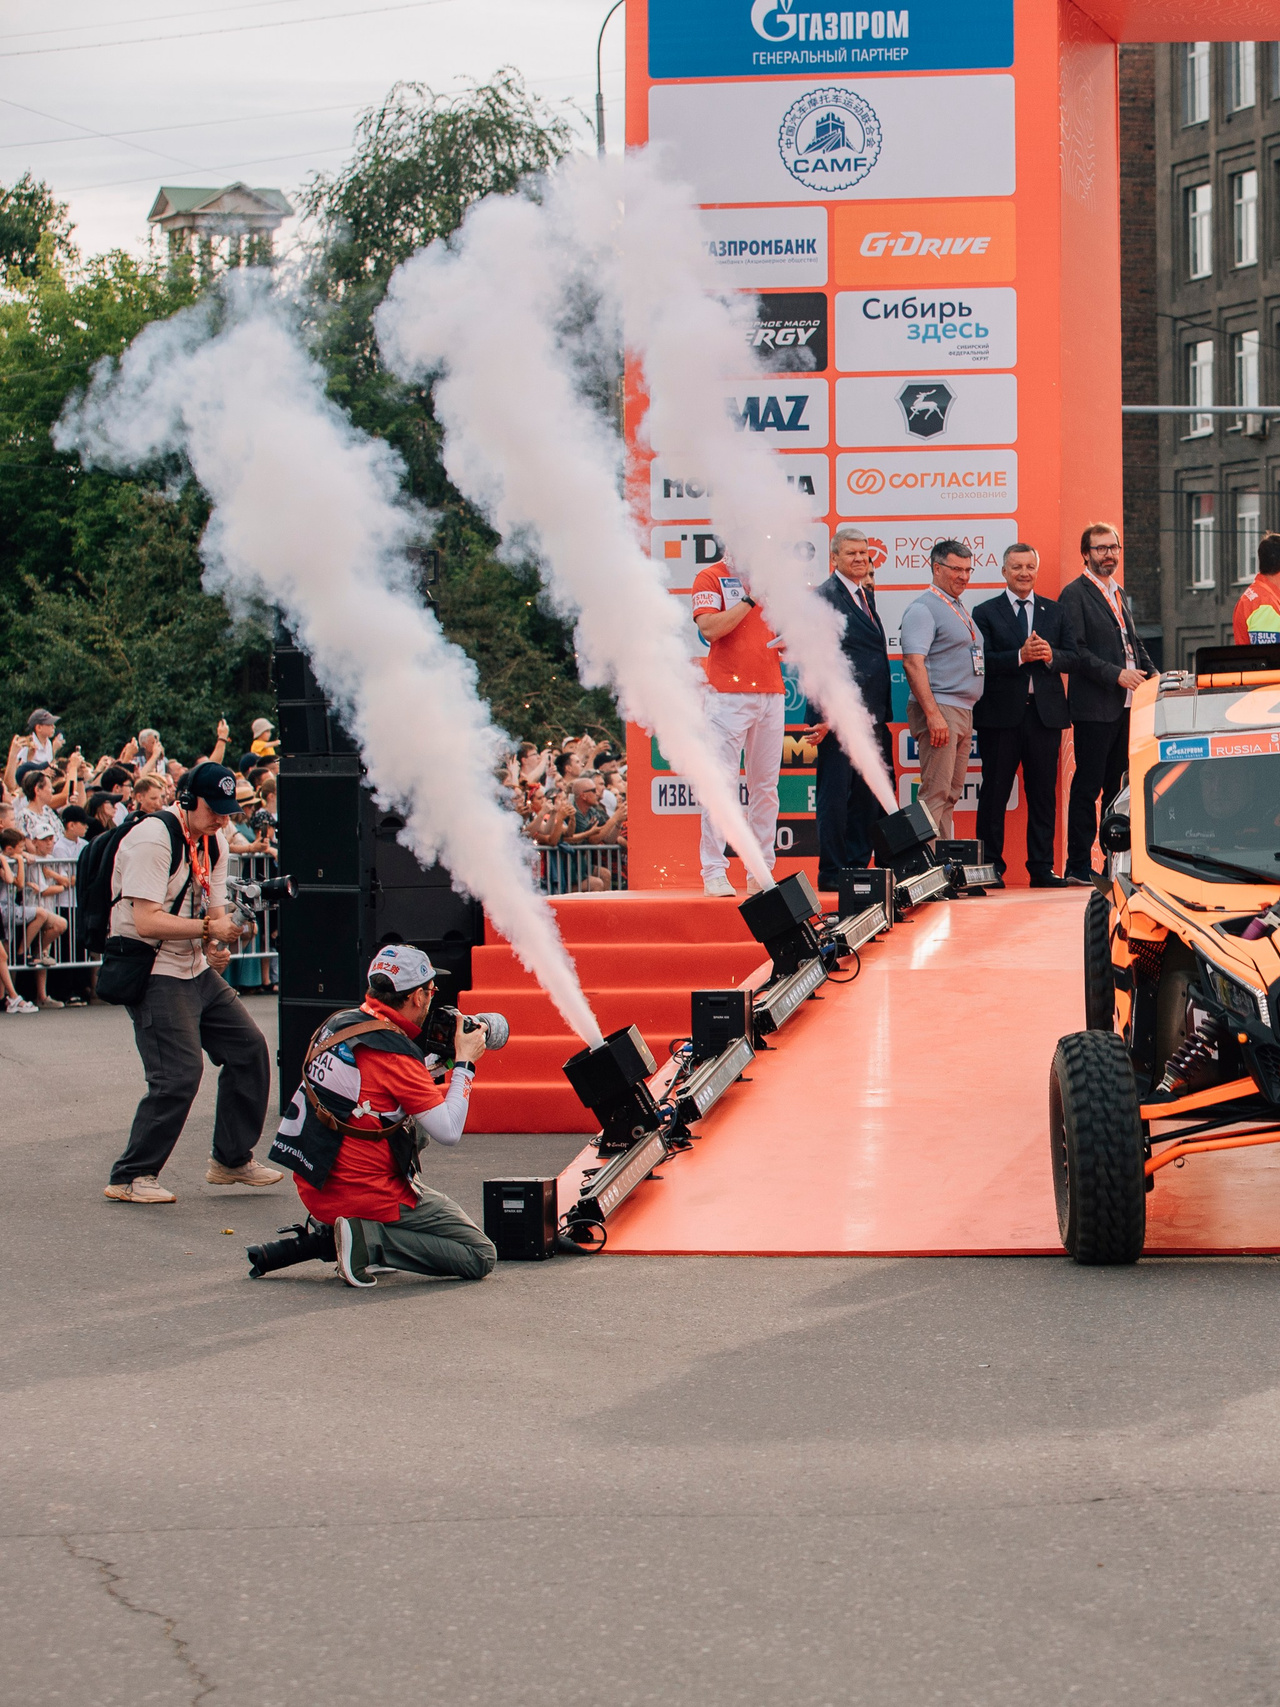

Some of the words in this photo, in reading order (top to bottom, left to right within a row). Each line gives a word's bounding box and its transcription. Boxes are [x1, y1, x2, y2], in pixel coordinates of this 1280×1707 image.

[797, 10, 909, 41] ГАЗПРОМ
[752, 48, 848, 65] ГЕНЕРАЛЬНЫЙ
[851, 47, 909, 62] ПАРТНЕР
[793, 158, 867, 173] CAMF
[862, 297, 972, 323] Сибирь
[907, 321, 989, 343] здесь
[728, 395, 810, 431] MAZ
[889, 471, 1007, 488] СОГЛАСИЕ
[940, 489, 1007, 501] страхование
[895, 553, 998, 568] МЕХКА
[1257, 632, 1276, 640] SILK
[1216, 744, 1262, 756] RUSSIA
